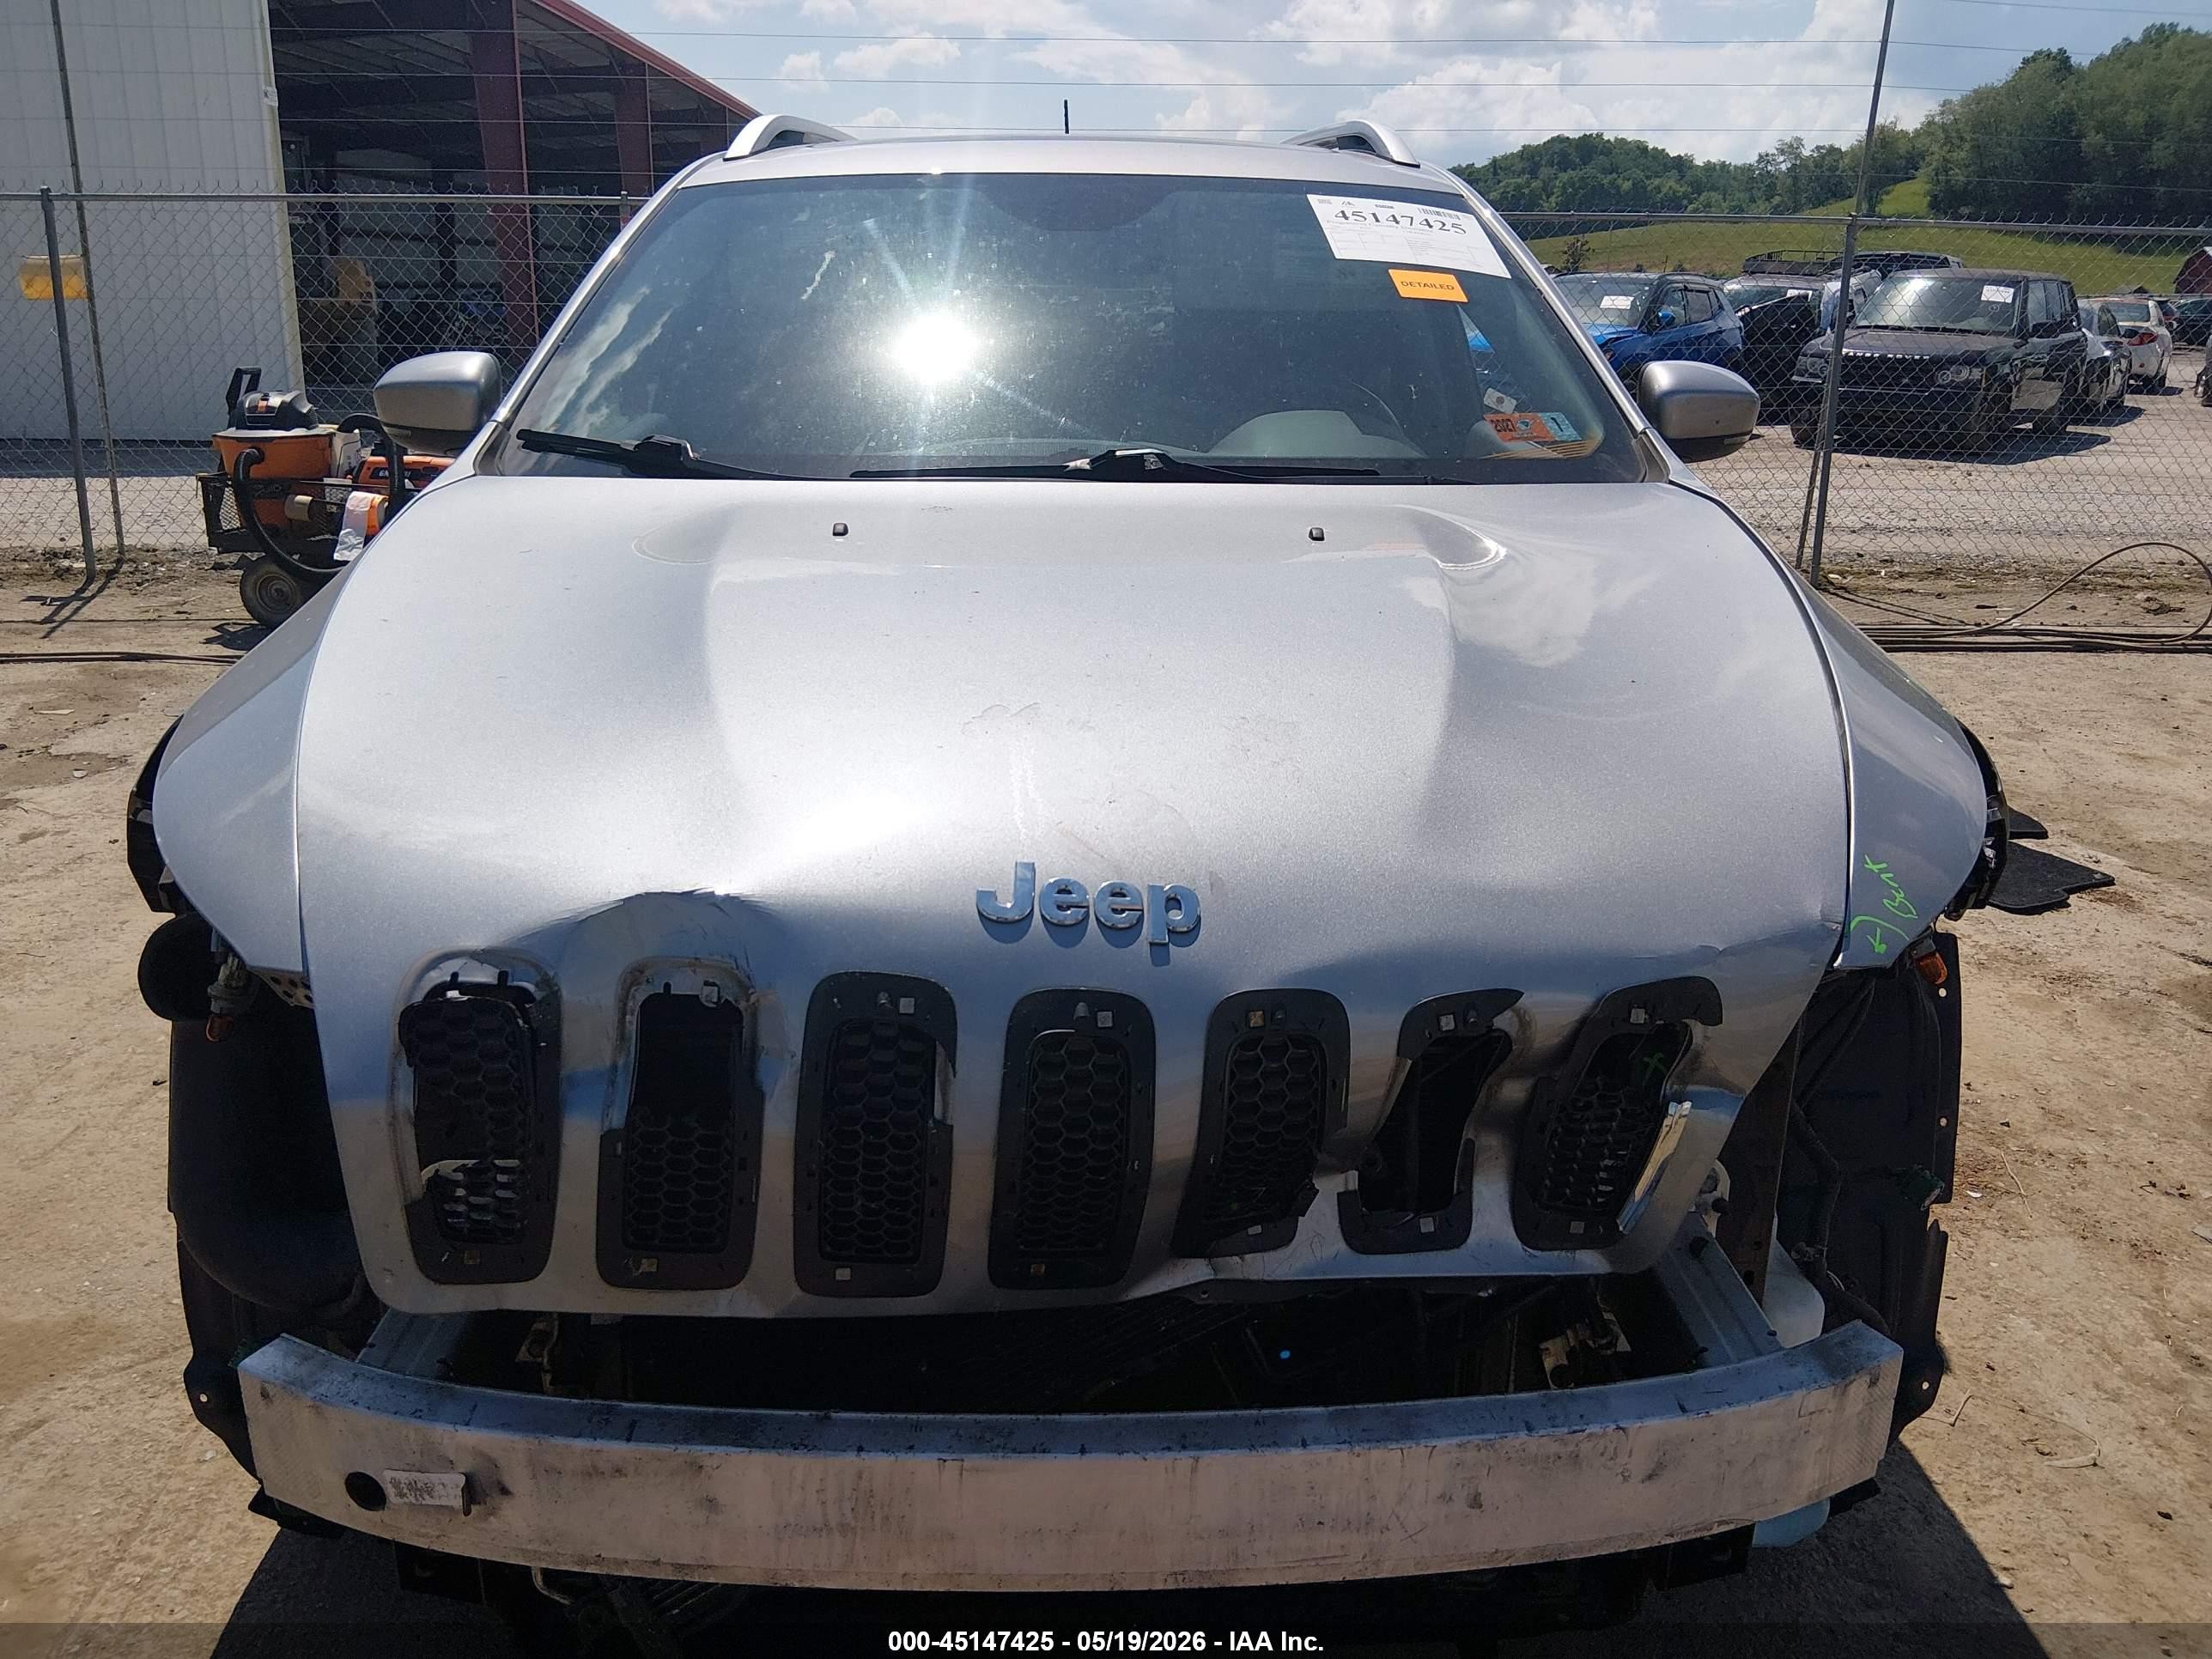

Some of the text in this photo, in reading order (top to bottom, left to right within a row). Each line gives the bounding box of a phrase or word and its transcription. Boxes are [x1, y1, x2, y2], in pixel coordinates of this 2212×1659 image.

[1334, 209, 1467, 234] 45147425
[1401, 280, 1455, 291] DETAILED
[1490, 418, 1517, 433] 2027
[976, 861, 1201, 944] Jeep
